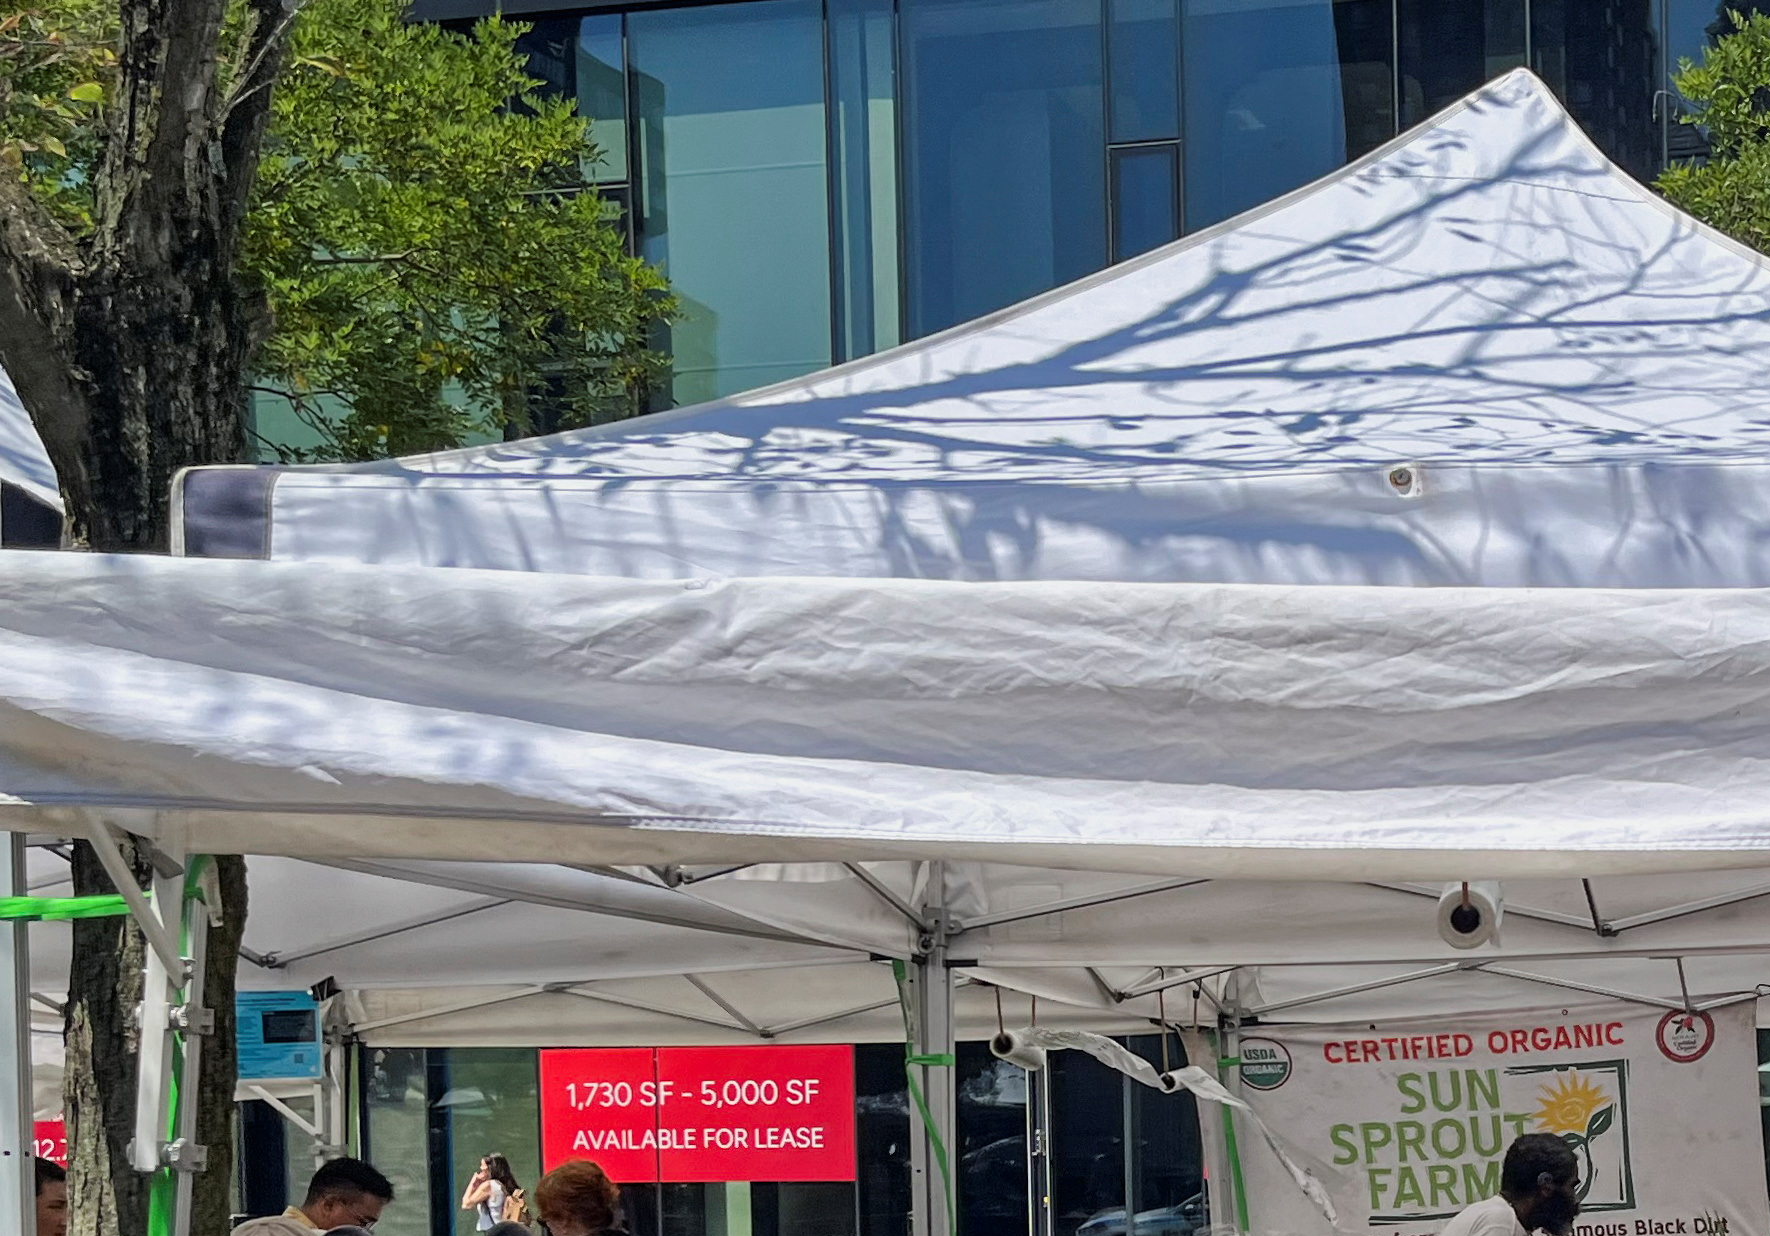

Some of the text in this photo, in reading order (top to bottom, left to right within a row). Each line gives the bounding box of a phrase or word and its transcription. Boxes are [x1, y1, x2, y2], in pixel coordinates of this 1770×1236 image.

[1244, 1049, 1277, 1060] USDA
[1323, 1022, 1625, 1064] CERTIFIED ORGANIC
[1243, 1064, 1285, 1075] ORGANIC
[565, 1081, 633, 1111] 1,730
[639, 1080, 674, 1107] SF
[701, 1080, 779, 1109] 5,000
[786, 1079, 820, 1105] SF
[1397, 1069, 1501, 1114] SUN
[573, 1126, 824, 1150] AVAILABLE FOR LEASE
[1330, 1112, 1533, 1165] SPROUT
[1635, 1218, 1686, 1236] Black
